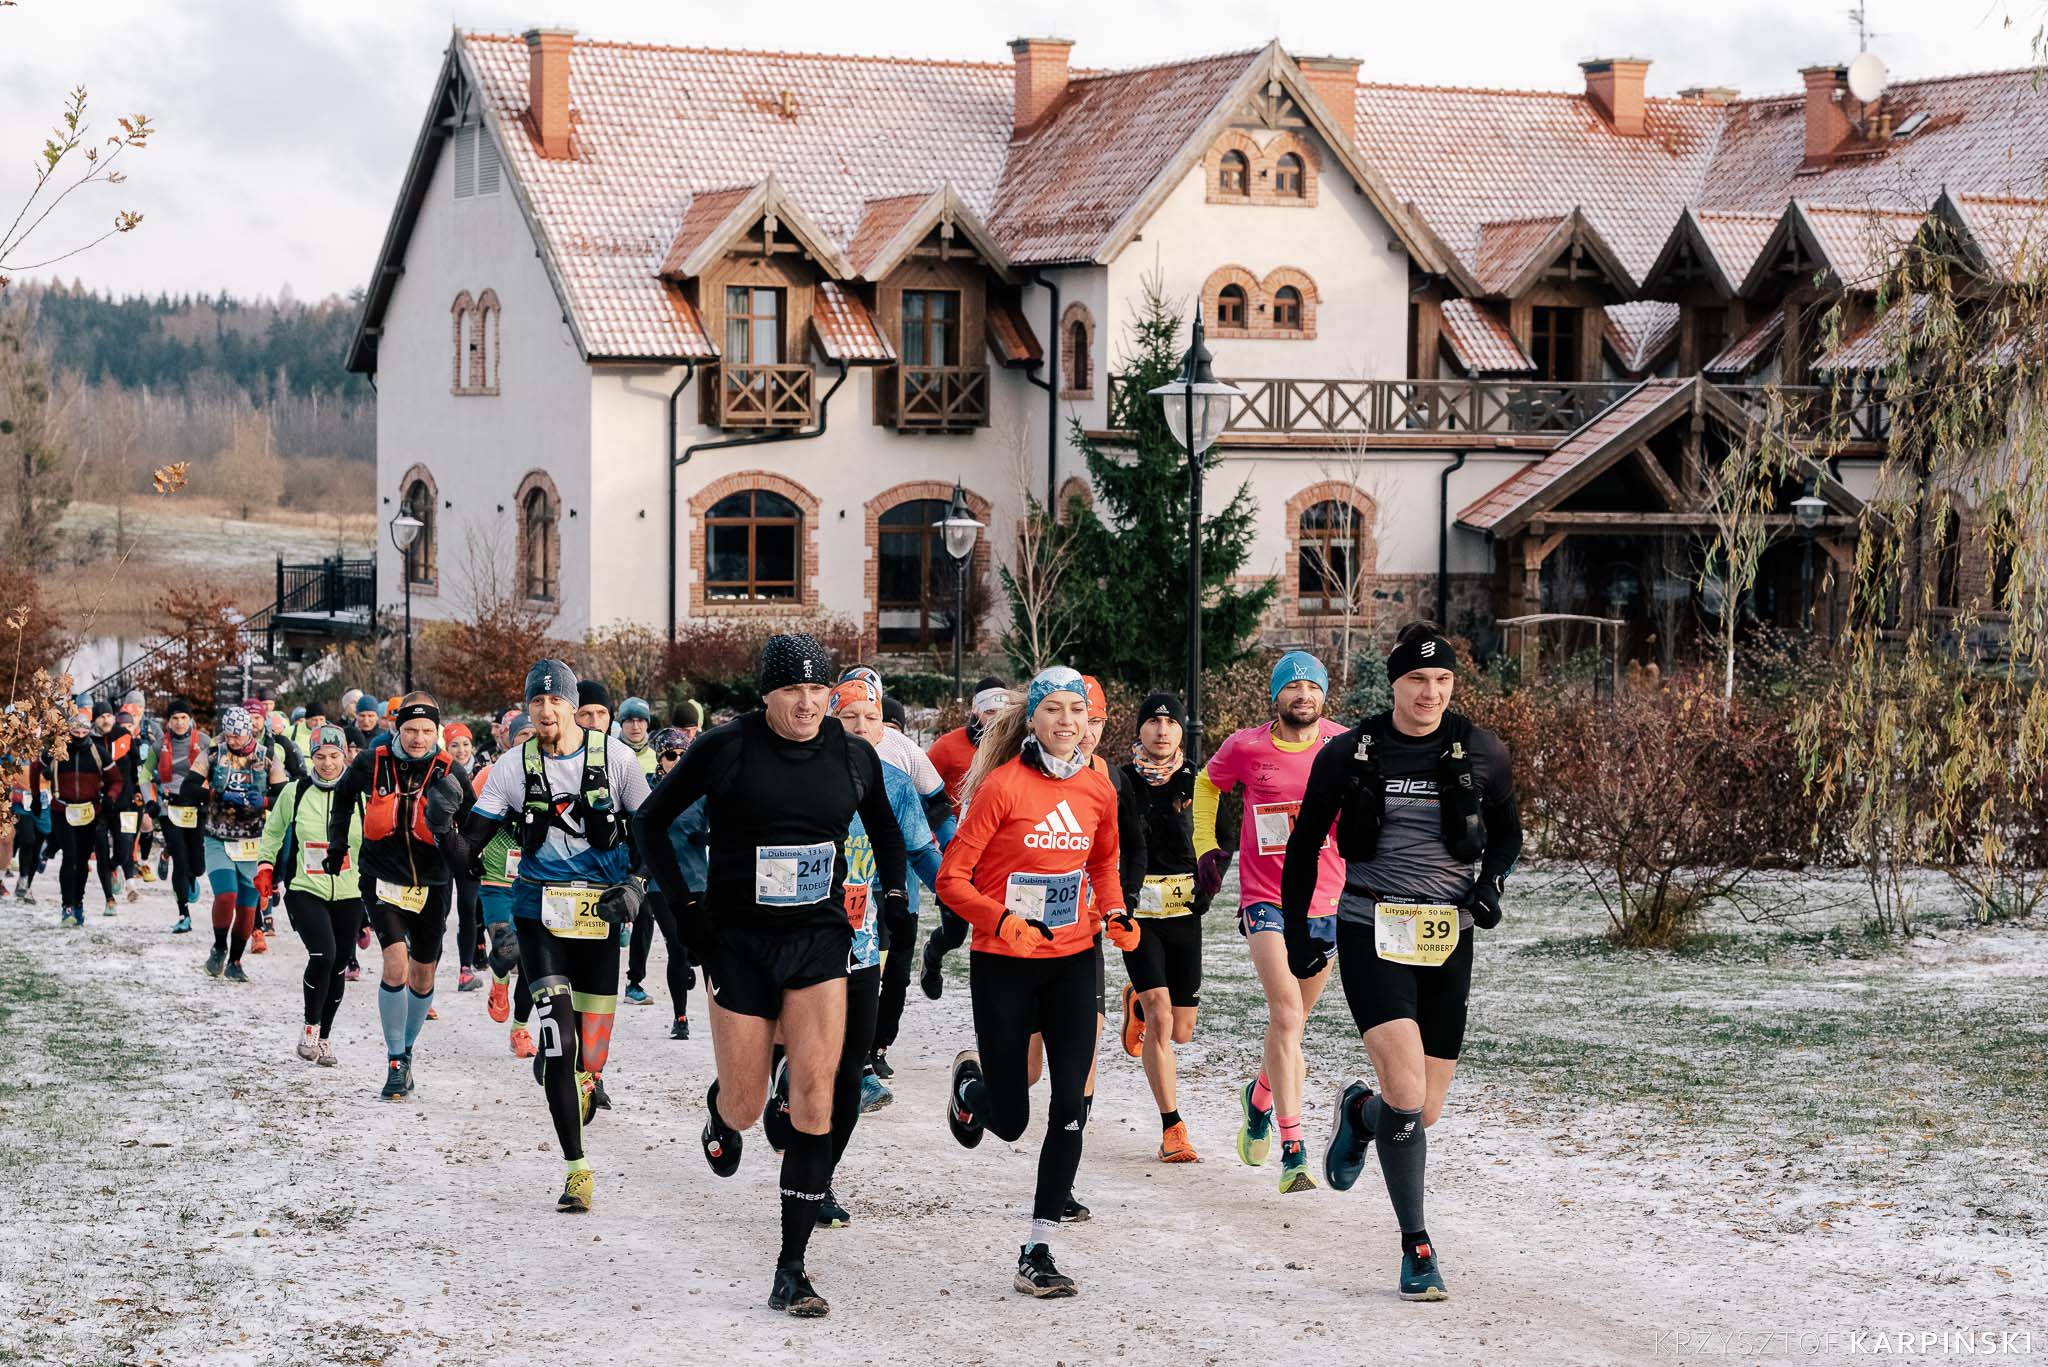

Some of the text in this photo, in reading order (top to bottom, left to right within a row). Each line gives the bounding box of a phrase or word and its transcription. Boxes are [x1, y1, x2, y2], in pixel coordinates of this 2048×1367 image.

[244, 842, 255, 850] 11
[1023, 831, 1090, 850] adidas
[797, 857, 830, 878] 241
[798, 879, 830, 891] TADEUSZ
[1018, 876, 1051, 884] Dubinek
[1045, 885, 1078, 904] 203
[1172, 886, 1183, 899] 4
[580, 901, 600, 917] 20
[1051, 907, 1071, 917] ANNA
[1385, 908, 1422, 916] Litygajno
[1422, 920, 1451, 939] 39
[1417, 944, 1454, 952] NORBERT
